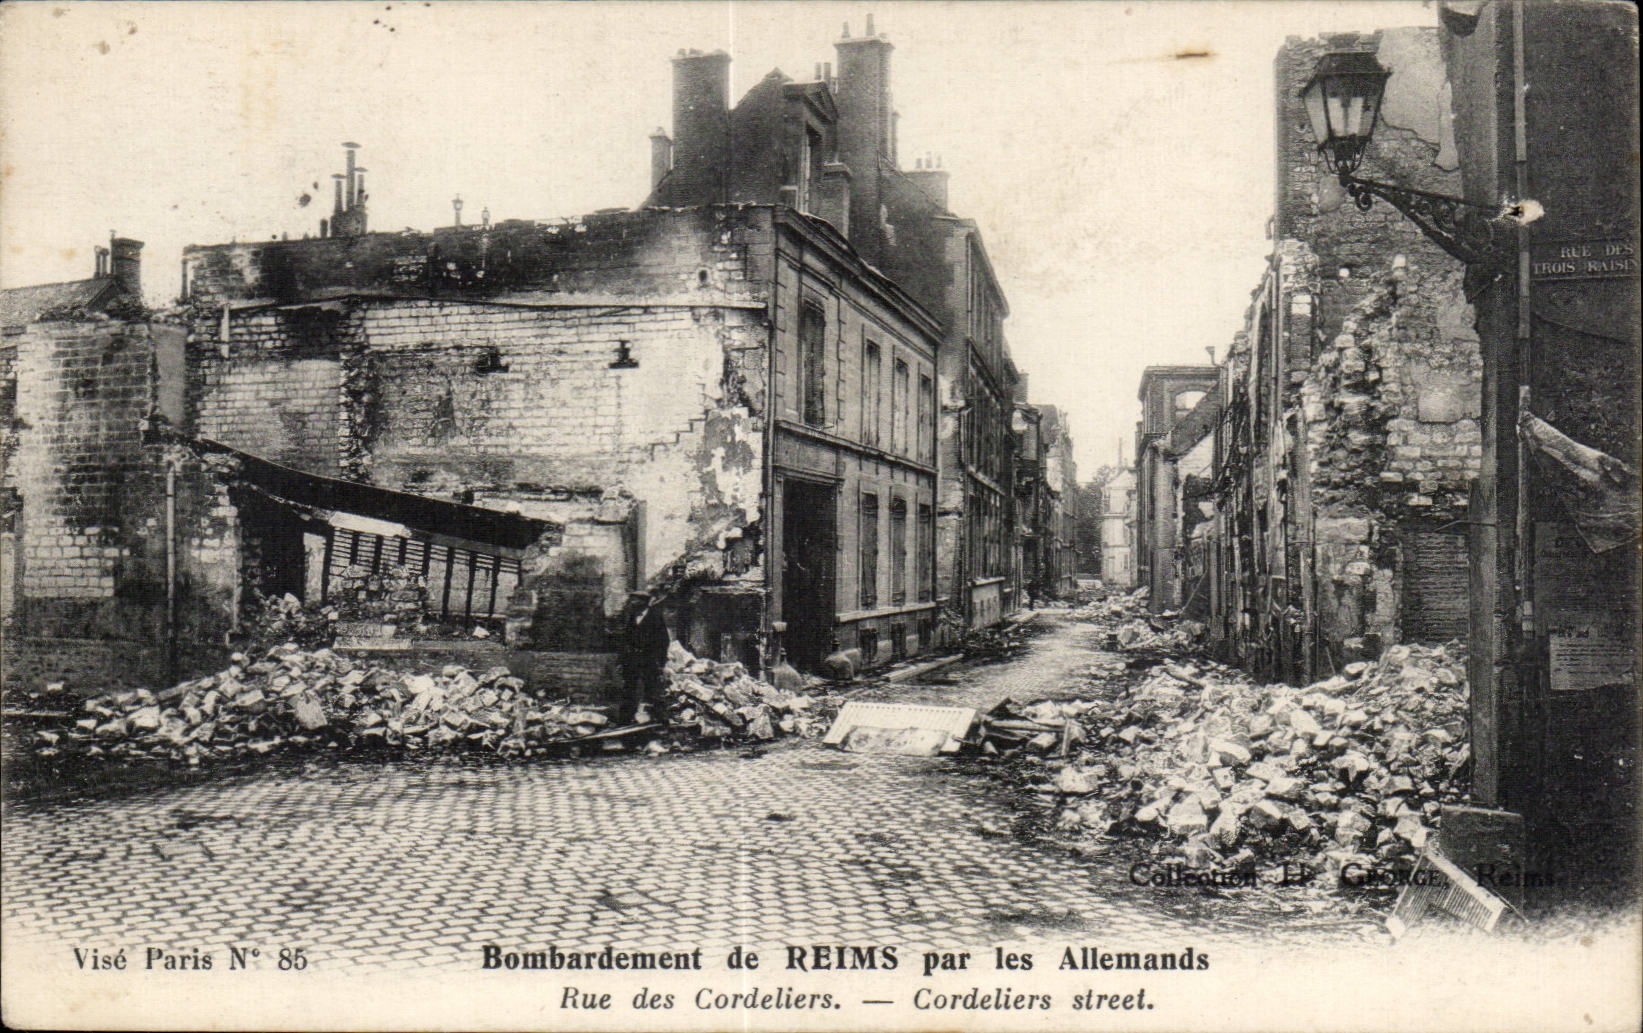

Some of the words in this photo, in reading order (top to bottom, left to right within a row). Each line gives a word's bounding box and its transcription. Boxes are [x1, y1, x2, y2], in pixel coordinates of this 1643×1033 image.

[1560, 245, 1592, 258] RUE
[1605, 243, 1634, 256] DES
[1532, 261, 1576, 275] TROIS
